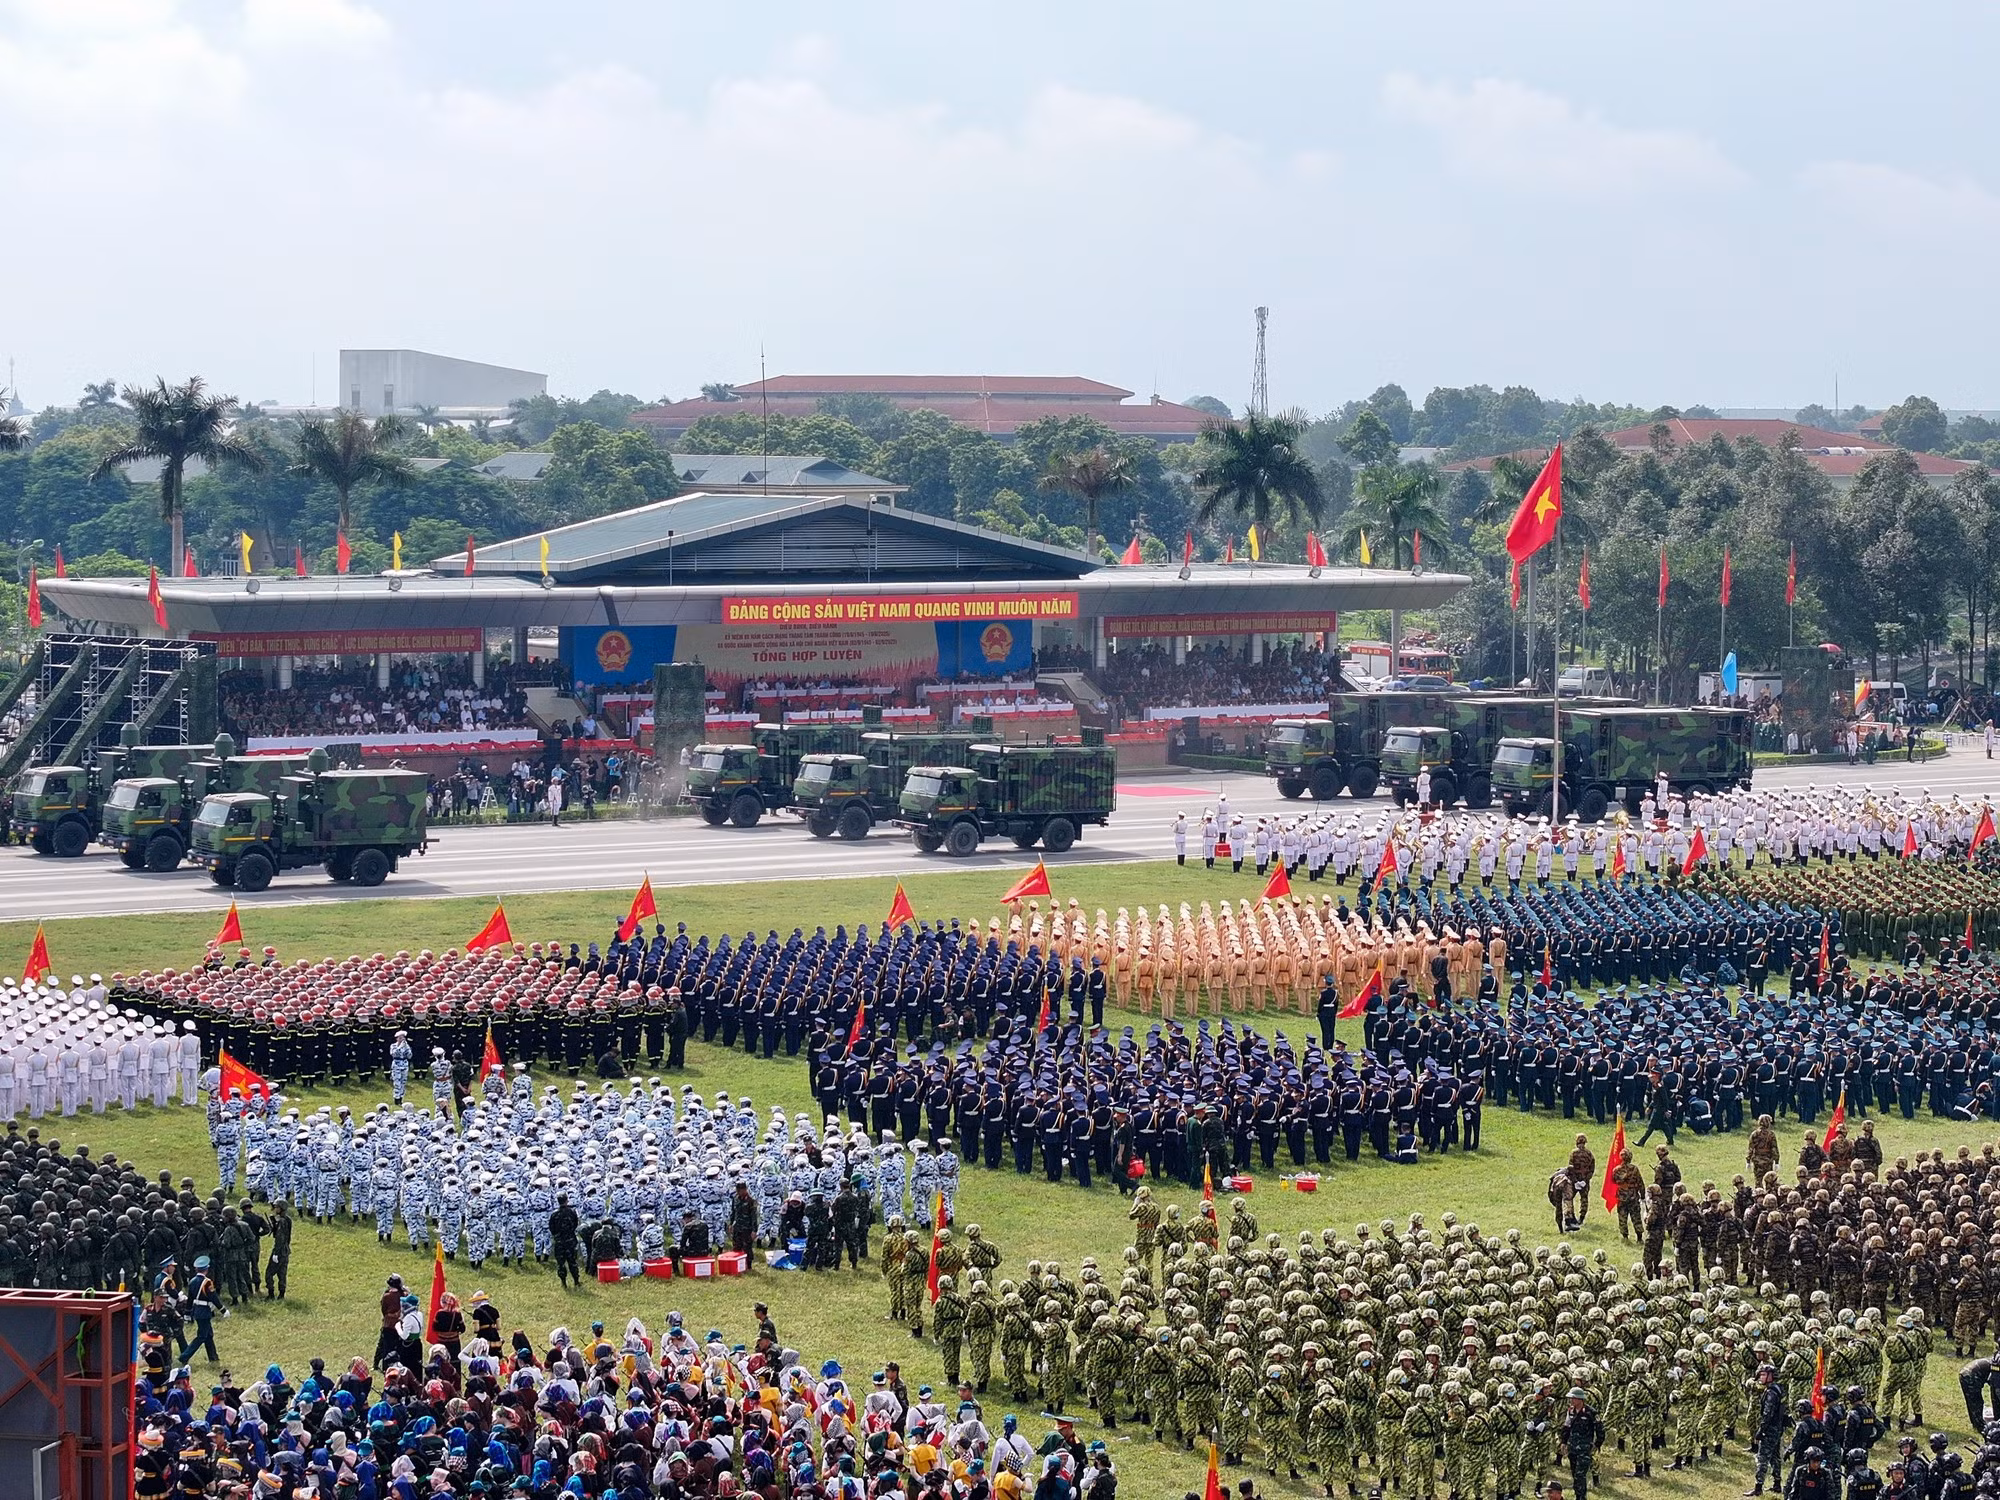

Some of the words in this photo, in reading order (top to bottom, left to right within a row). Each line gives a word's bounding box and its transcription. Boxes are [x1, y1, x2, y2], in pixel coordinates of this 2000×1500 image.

[729, 599, 769, 620] ĐẢNG
[772, 601, 811, 622] CỘNG
[814, 598, 844, 619] SẢN
[847, 600, 876, 621] VIỆT
[879, 603, 911, 618] NAM
[914, 602, 960, 618] QUANG
[963, 601, 995, 617] VINH
[998, 598, 1038, 616] MUÔN
[1041, 597, 1072, 615] NĂM
[752, 648, 787, 662] TỔNG
[792, 650, 818, 663] HỢP
[823, 648, 862, 662] LUYỆN
